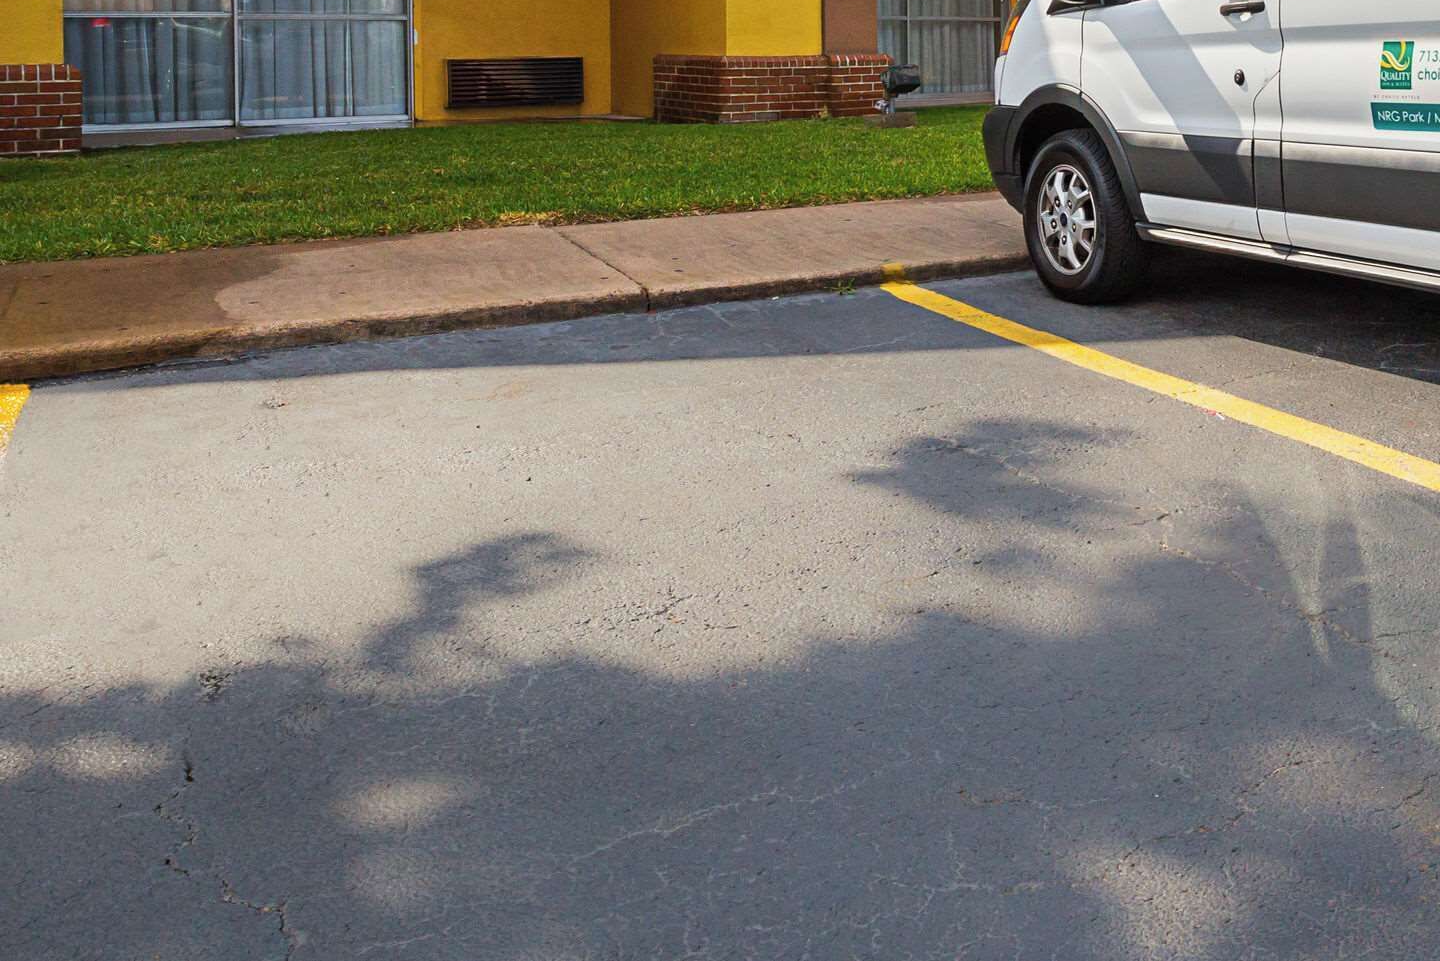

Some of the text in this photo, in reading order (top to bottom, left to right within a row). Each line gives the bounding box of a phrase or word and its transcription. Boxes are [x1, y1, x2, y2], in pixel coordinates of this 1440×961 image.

[1380, 71, 1411, 82] QUALITY
[1377, 110, 1401, 122] NRG
[1402, 111, 1425, 123] Park
